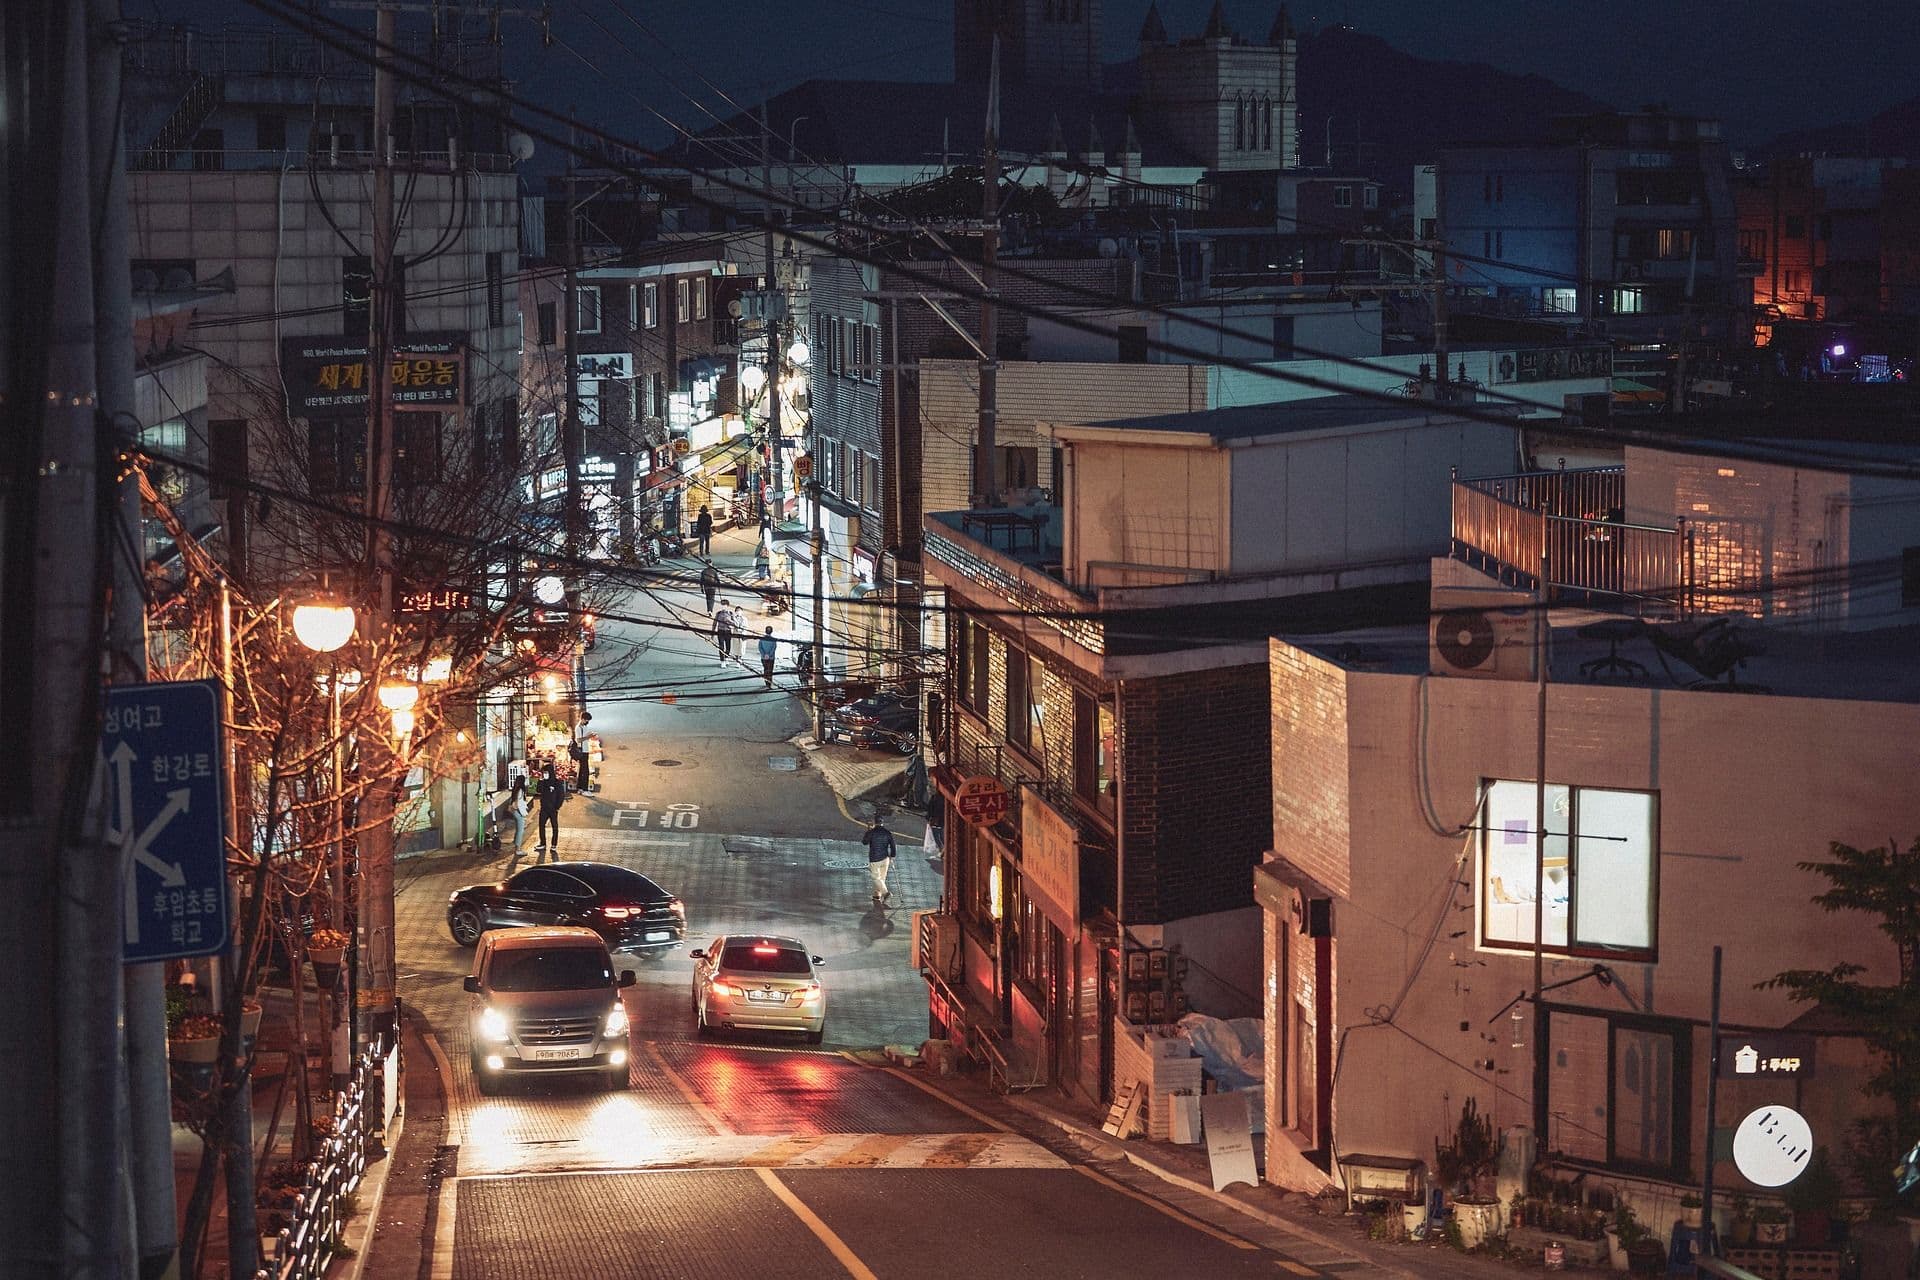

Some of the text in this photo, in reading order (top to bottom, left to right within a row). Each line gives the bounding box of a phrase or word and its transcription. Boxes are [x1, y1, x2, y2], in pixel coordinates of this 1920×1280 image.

[797, 460, 810, 475] 빵
[152, 753, 211, 783] 한강로
[963, 794, 1004, 812] 복사
